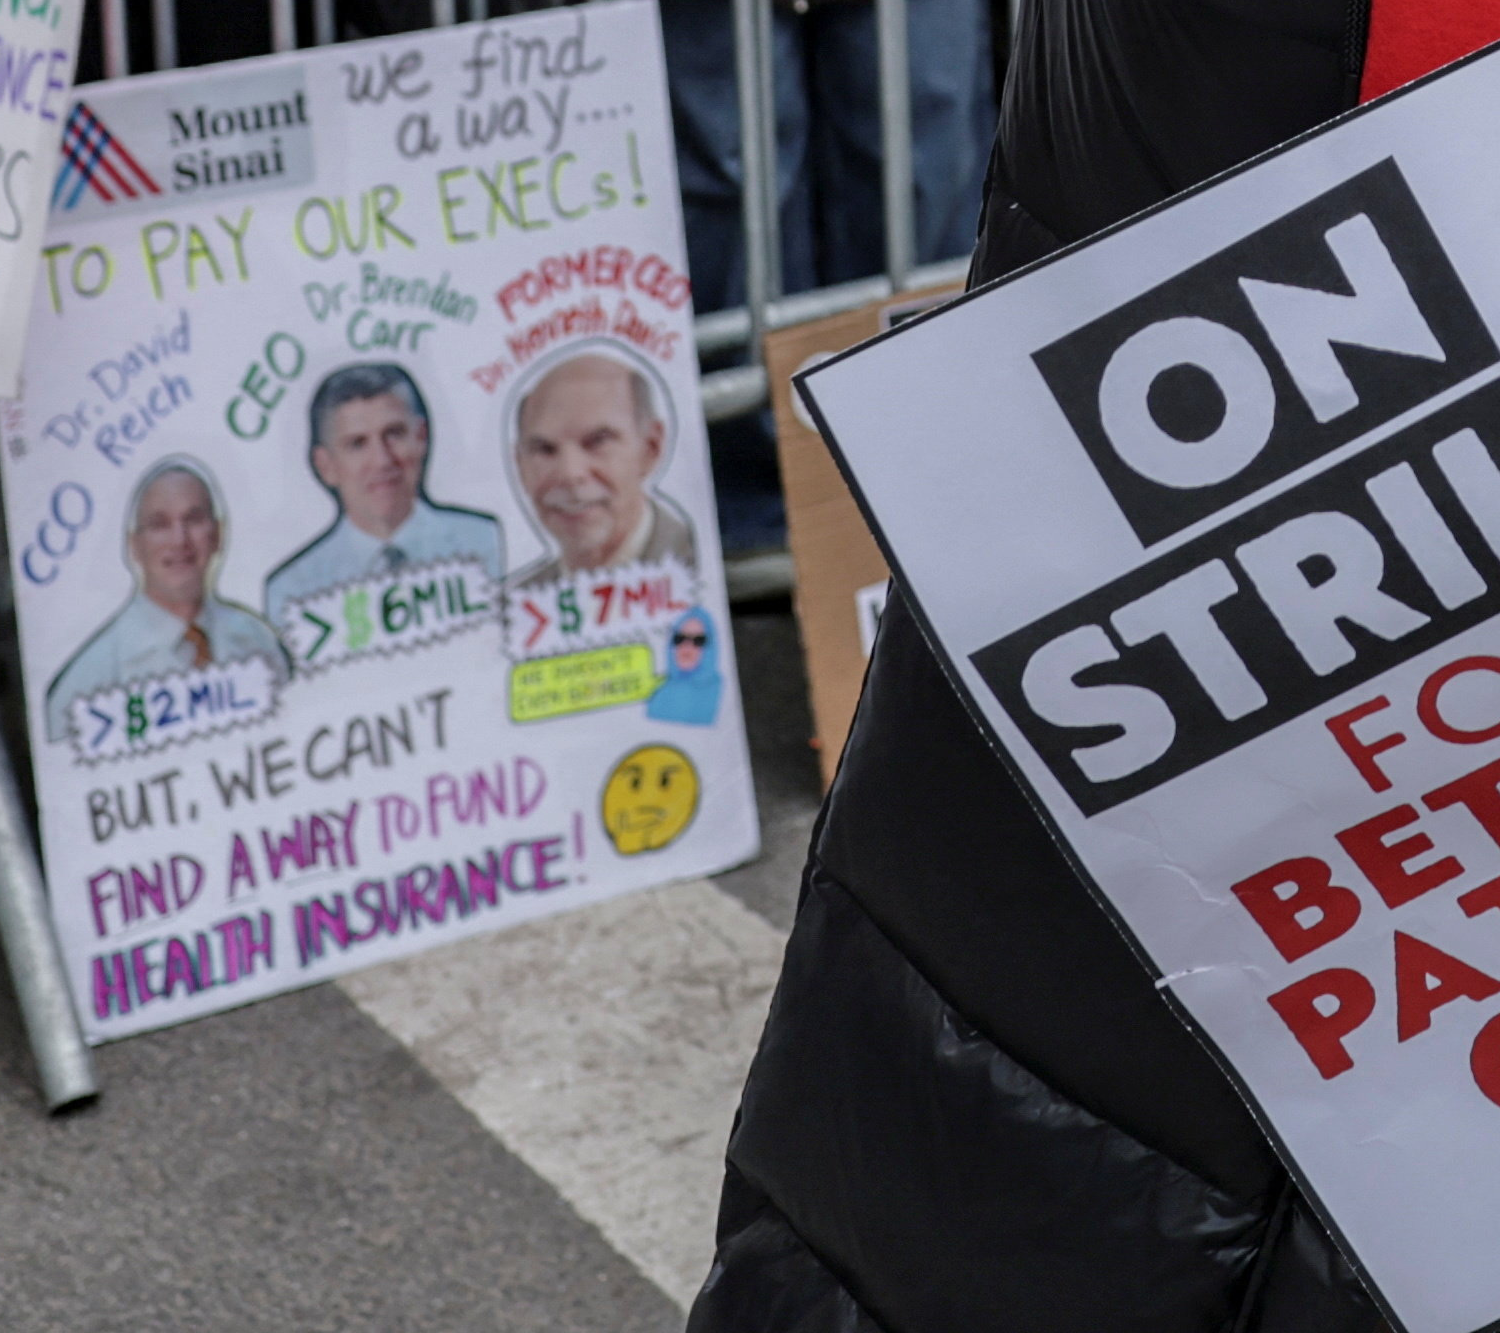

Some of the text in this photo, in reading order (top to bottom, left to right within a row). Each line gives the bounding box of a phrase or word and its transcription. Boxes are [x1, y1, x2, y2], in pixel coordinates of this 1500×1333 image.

[462, 10, 607, 99] find
[168, 90, 308, 146] Mount
[172, 136, 285, 194] Sinai
[395, 112, 441, 159] a
[41, 242, 114, 316] TO
[141, 206, 253, 301] PAY
[294, 184, 418, 261] OUR
[494, 244, 634, 324] FORMER
[88, 306, 193, 403] David
[346, 307, 437, 353] Carr
[1098, 210, 1447, 491] ON
[93, 373, 195, 468] Reich
[225, 331, 306, 441] CEO
[21, 480, 95, 587] CCO
[208, 738, 296, 808] WE
[303, 686, 453, 782] CAN'T
[87, 755, 548, 939] FIND A WAY TO FUND
[90, 909, 275, 1022] HEALTH
